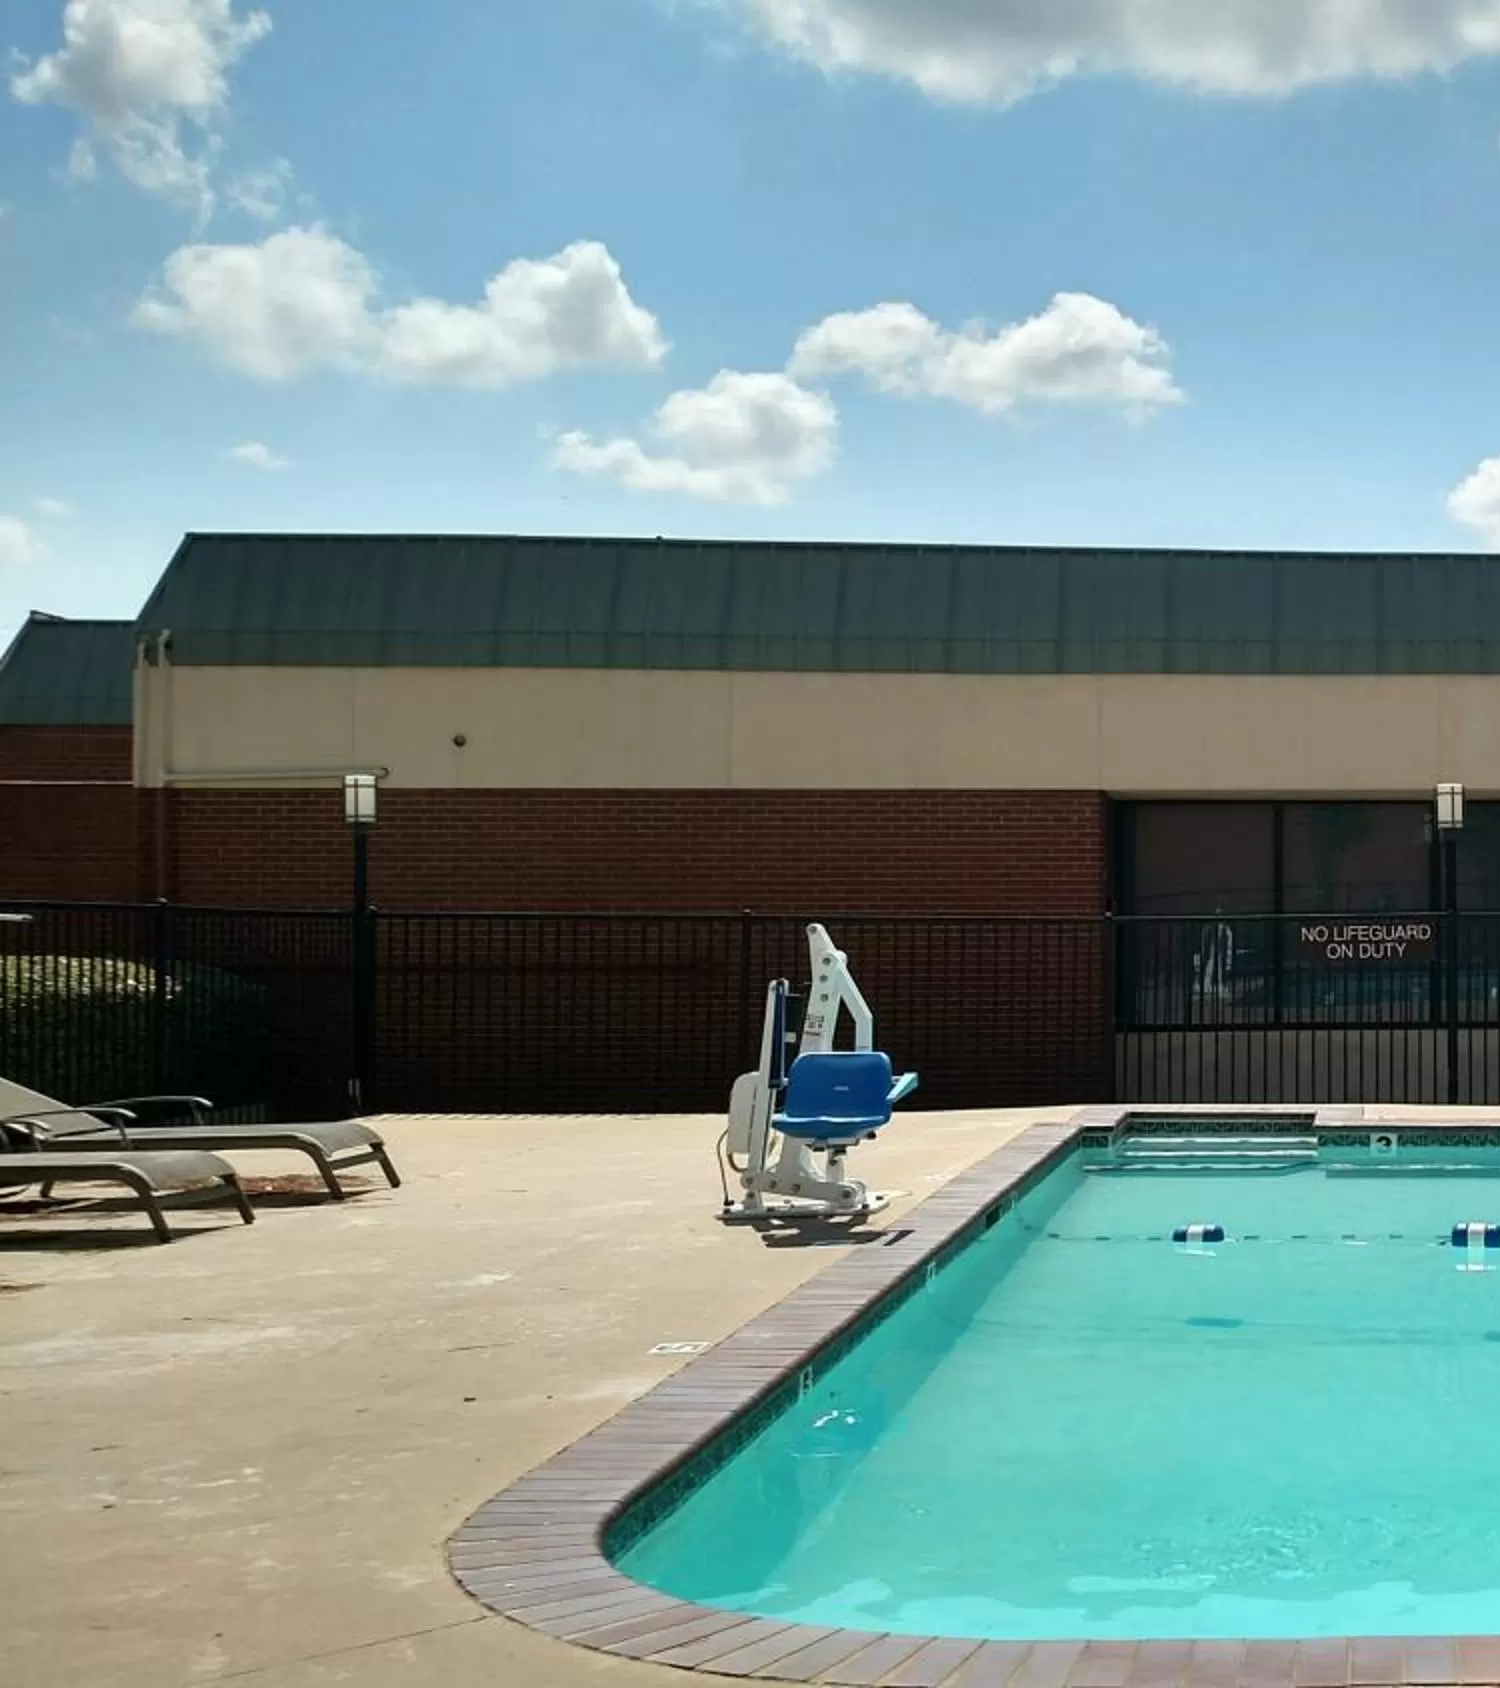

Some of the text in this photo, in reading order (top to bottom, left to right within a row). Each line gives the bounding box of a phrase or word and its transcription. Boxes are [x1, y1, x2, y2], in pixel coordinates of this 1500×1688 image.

[1301, 924, 1431, 942] NO LIFEGUARD
[1326, 943, 1407, 959] ON DUTY
